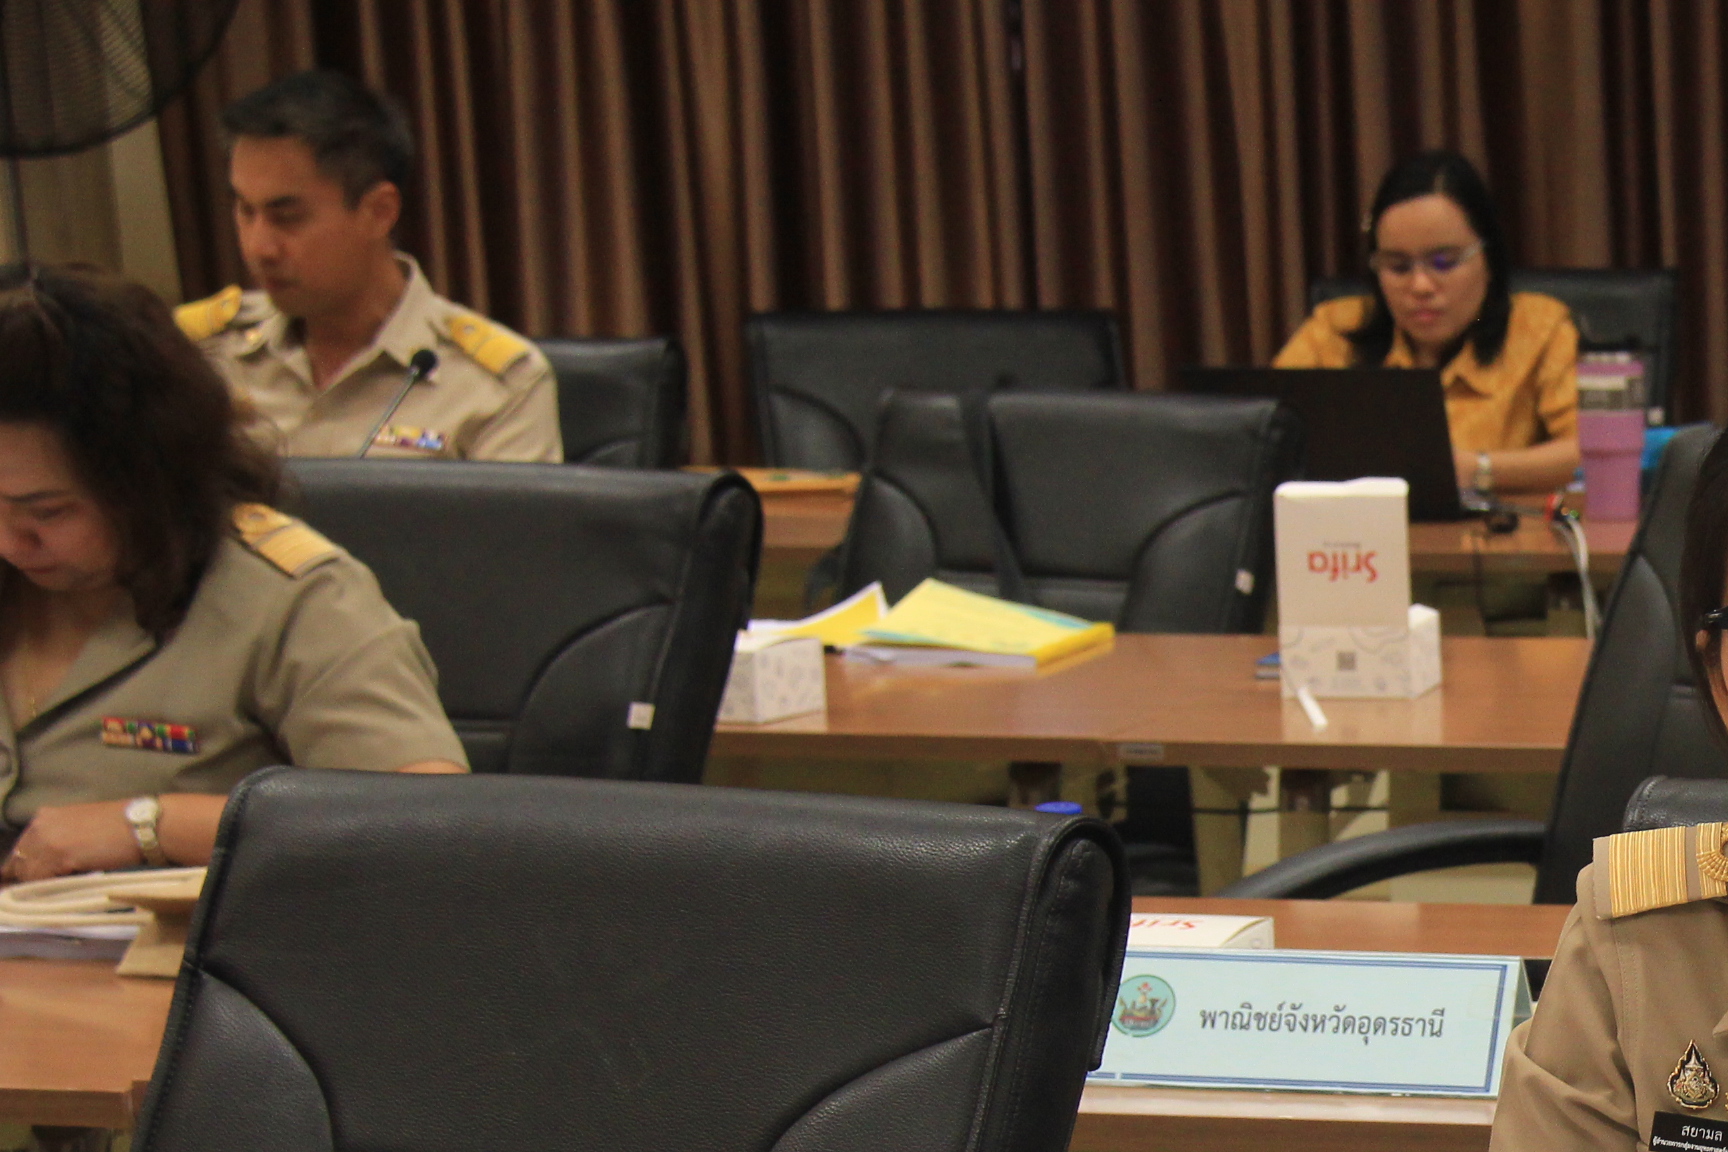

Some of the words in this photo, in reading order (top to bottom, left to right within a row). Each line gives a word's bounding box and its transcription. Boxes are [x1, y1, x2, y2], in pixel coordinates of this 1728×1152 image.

[1306, 550, 1380, 584] Srifa
[1199, 1001, 1446, 1045] พาณิชย์จังหวัดอุดรธานี
[1681, 1124, 1723, 1142] สยามล
